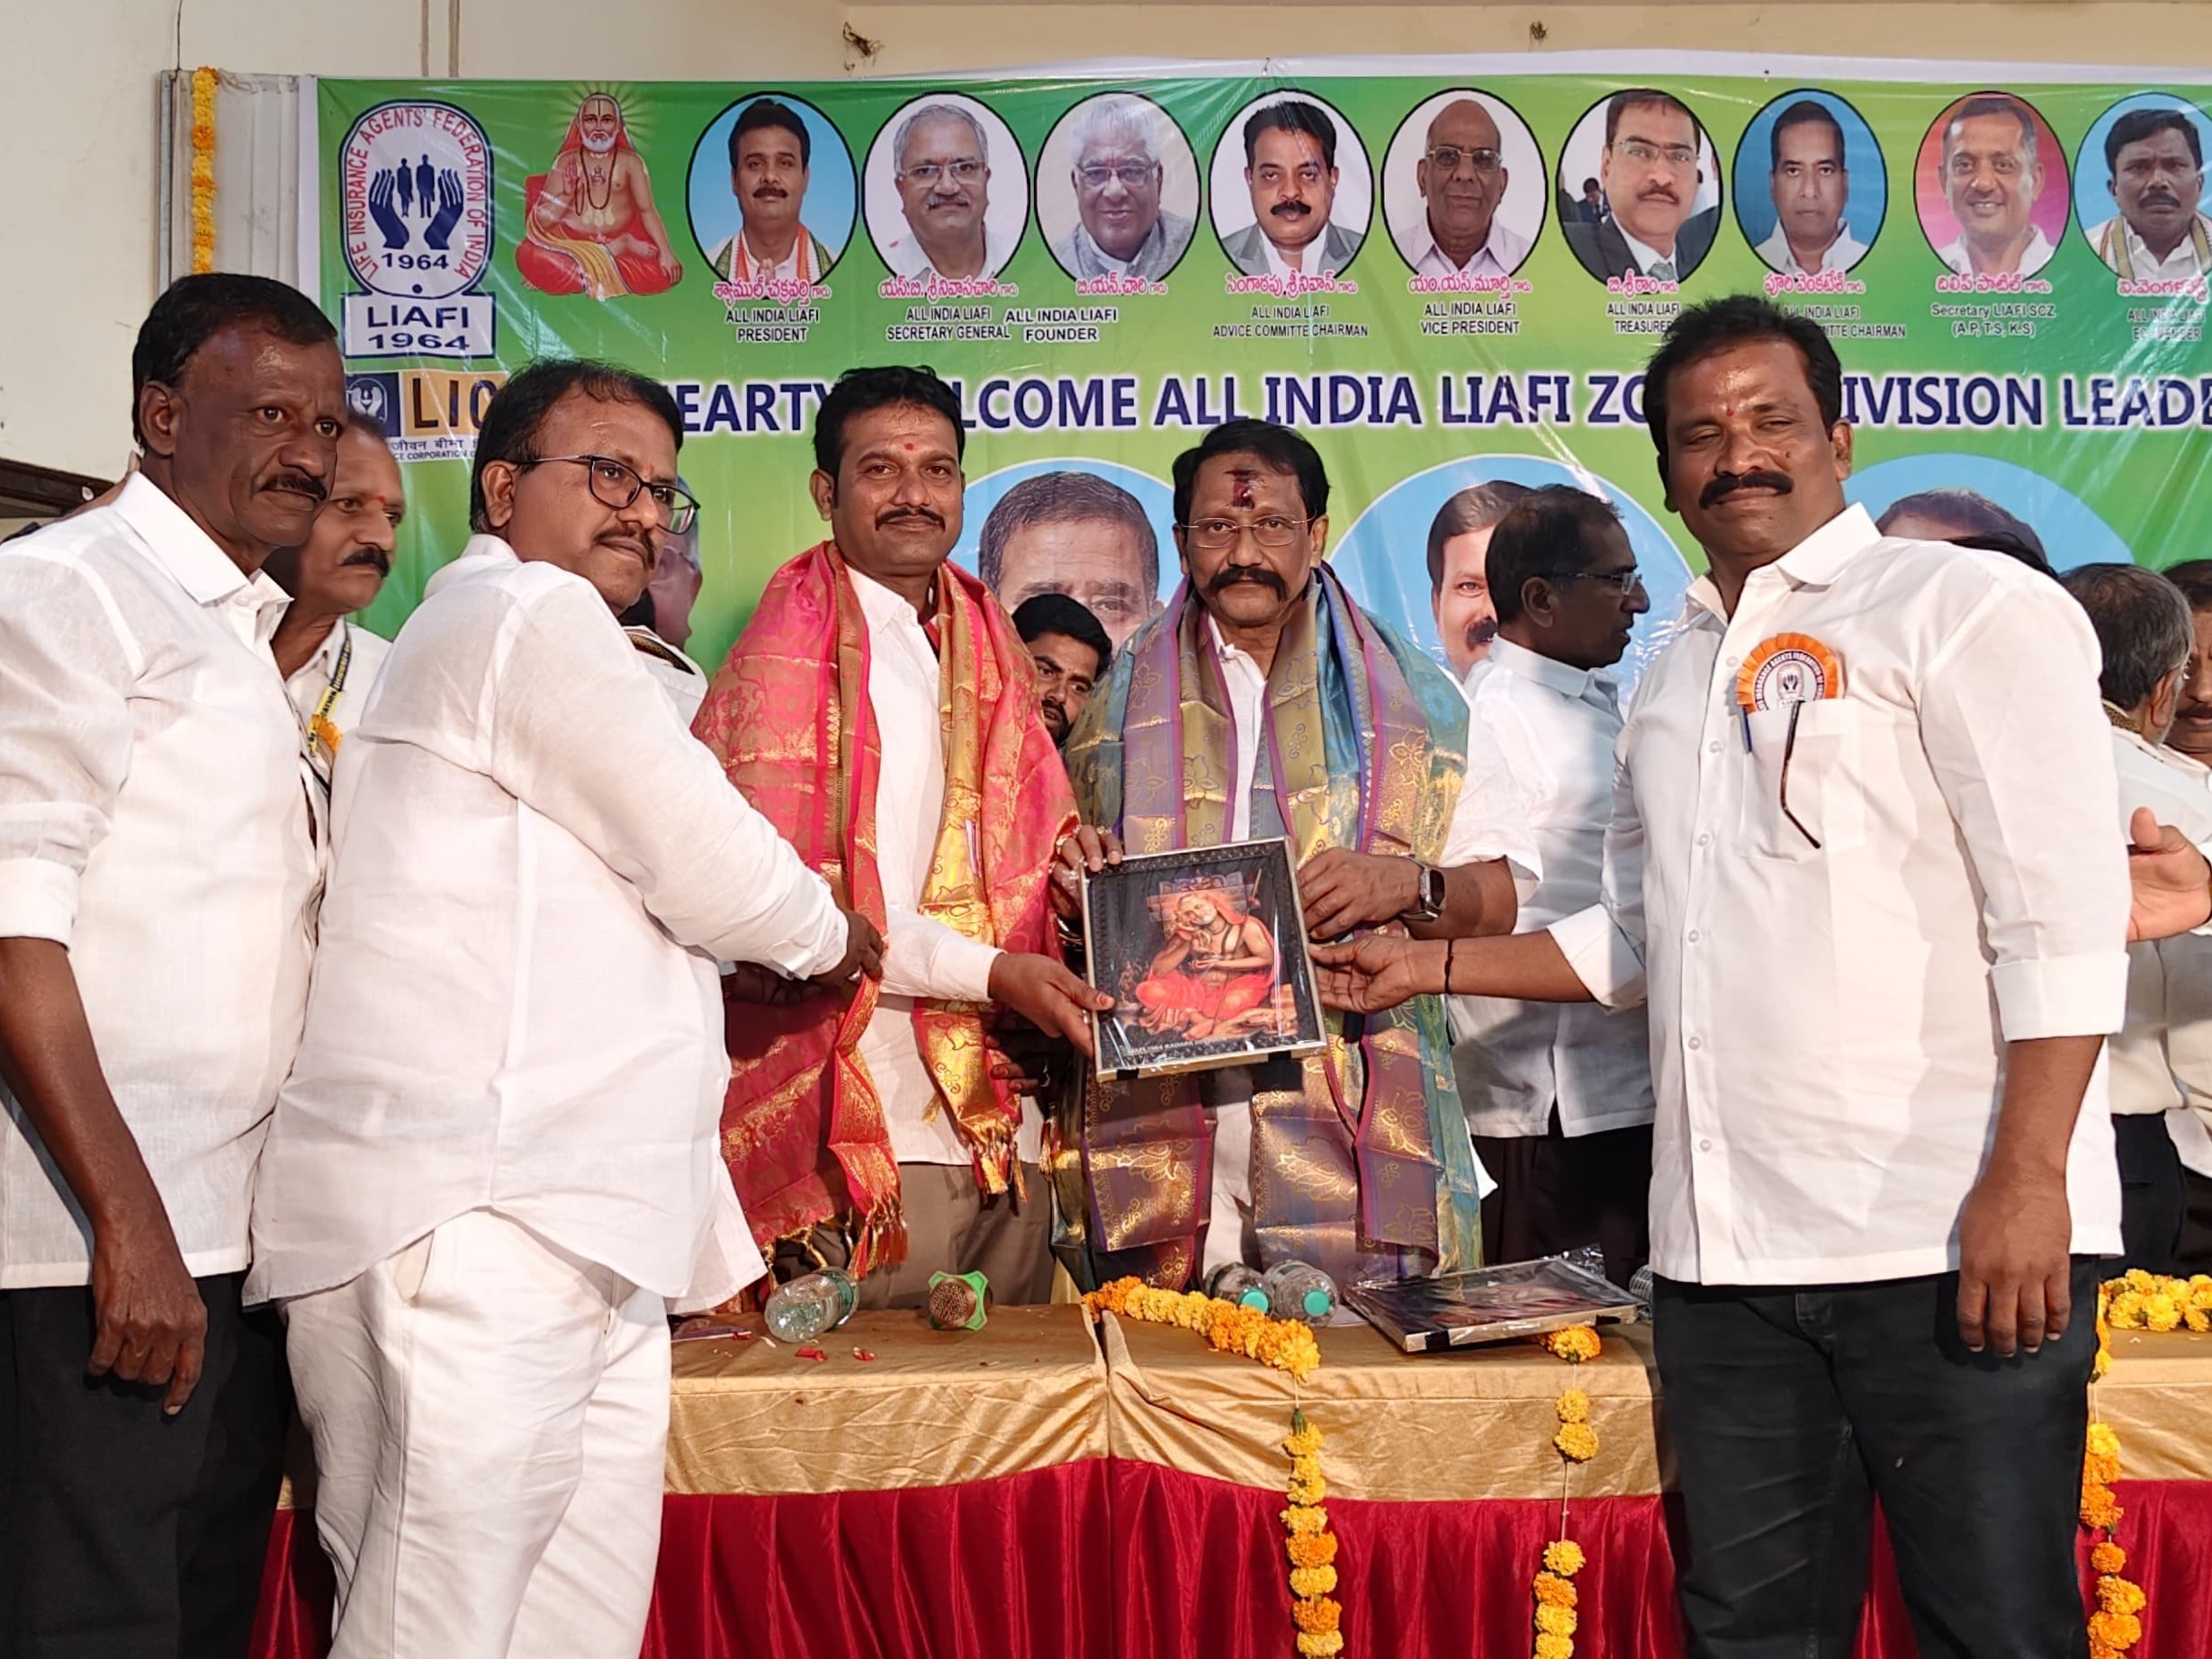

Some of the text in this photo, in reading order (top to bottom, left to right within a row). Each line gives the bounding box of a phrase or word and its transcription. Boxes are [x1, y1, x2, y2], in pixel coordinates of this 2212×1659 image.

[433, 110, 486, 203] FEDERATION
[348, 147, 368, 235] INSURANCE
[466, 208, 485, 229] OF
[350, 241, 379, 280] LIFE
[382, 253, 449, 270] 1964
[454, 233, 486, 279] INDIA
[725, 309, 819, 322] ALL INDIA LIAFI
[907, 307, 990, 320] ALL INDIA LIAFI
[1005, 309, 1117, 322] ALL INDIA LIAFI
[1252, 305, 1329, 318] ALL INDIA LIAFI
[1425, 302, 1515, 316] ALL INDIA LIAFI
[1607, 302, 1680, 315] ALL INDIA LIAFI
[1804, 307, 1831, 318] INDIA
[1835, 307, 1859, 318] LIAFI
[1932, 304, 2054, 318] Secretary LIAFI SCZ
[2128, 309, 2147, 321] ALL
[367, 305, 469, 328] LIAFI
[738, 327, 807, 341] PRESIDENT
[887, 325, 1010, 339] SECRETARY GENERAL
[1026, 327, 1097, 341] FOUNDER
[1213, 324, 1368, 336] ADVICE COMMITTE CHAIRMAN
[1421, 321, 1520, 334] VICE PRESIDENT
[1851, 325, 1906, 337] CHAIRMAN
[368, 333, 470, 350] 1964
[677, 383, 827, 432] EART
[952, 379, 1137, 429] LCOME
[1154, 377, 1248, 426] ALL
[1264, 376, 1422, 426] INDIA
[1442, 375, 1571, 423] LIAFI
[1842, 376, 2042, 426] IVISION
[407, 450, 468, 461] CORPORATION
